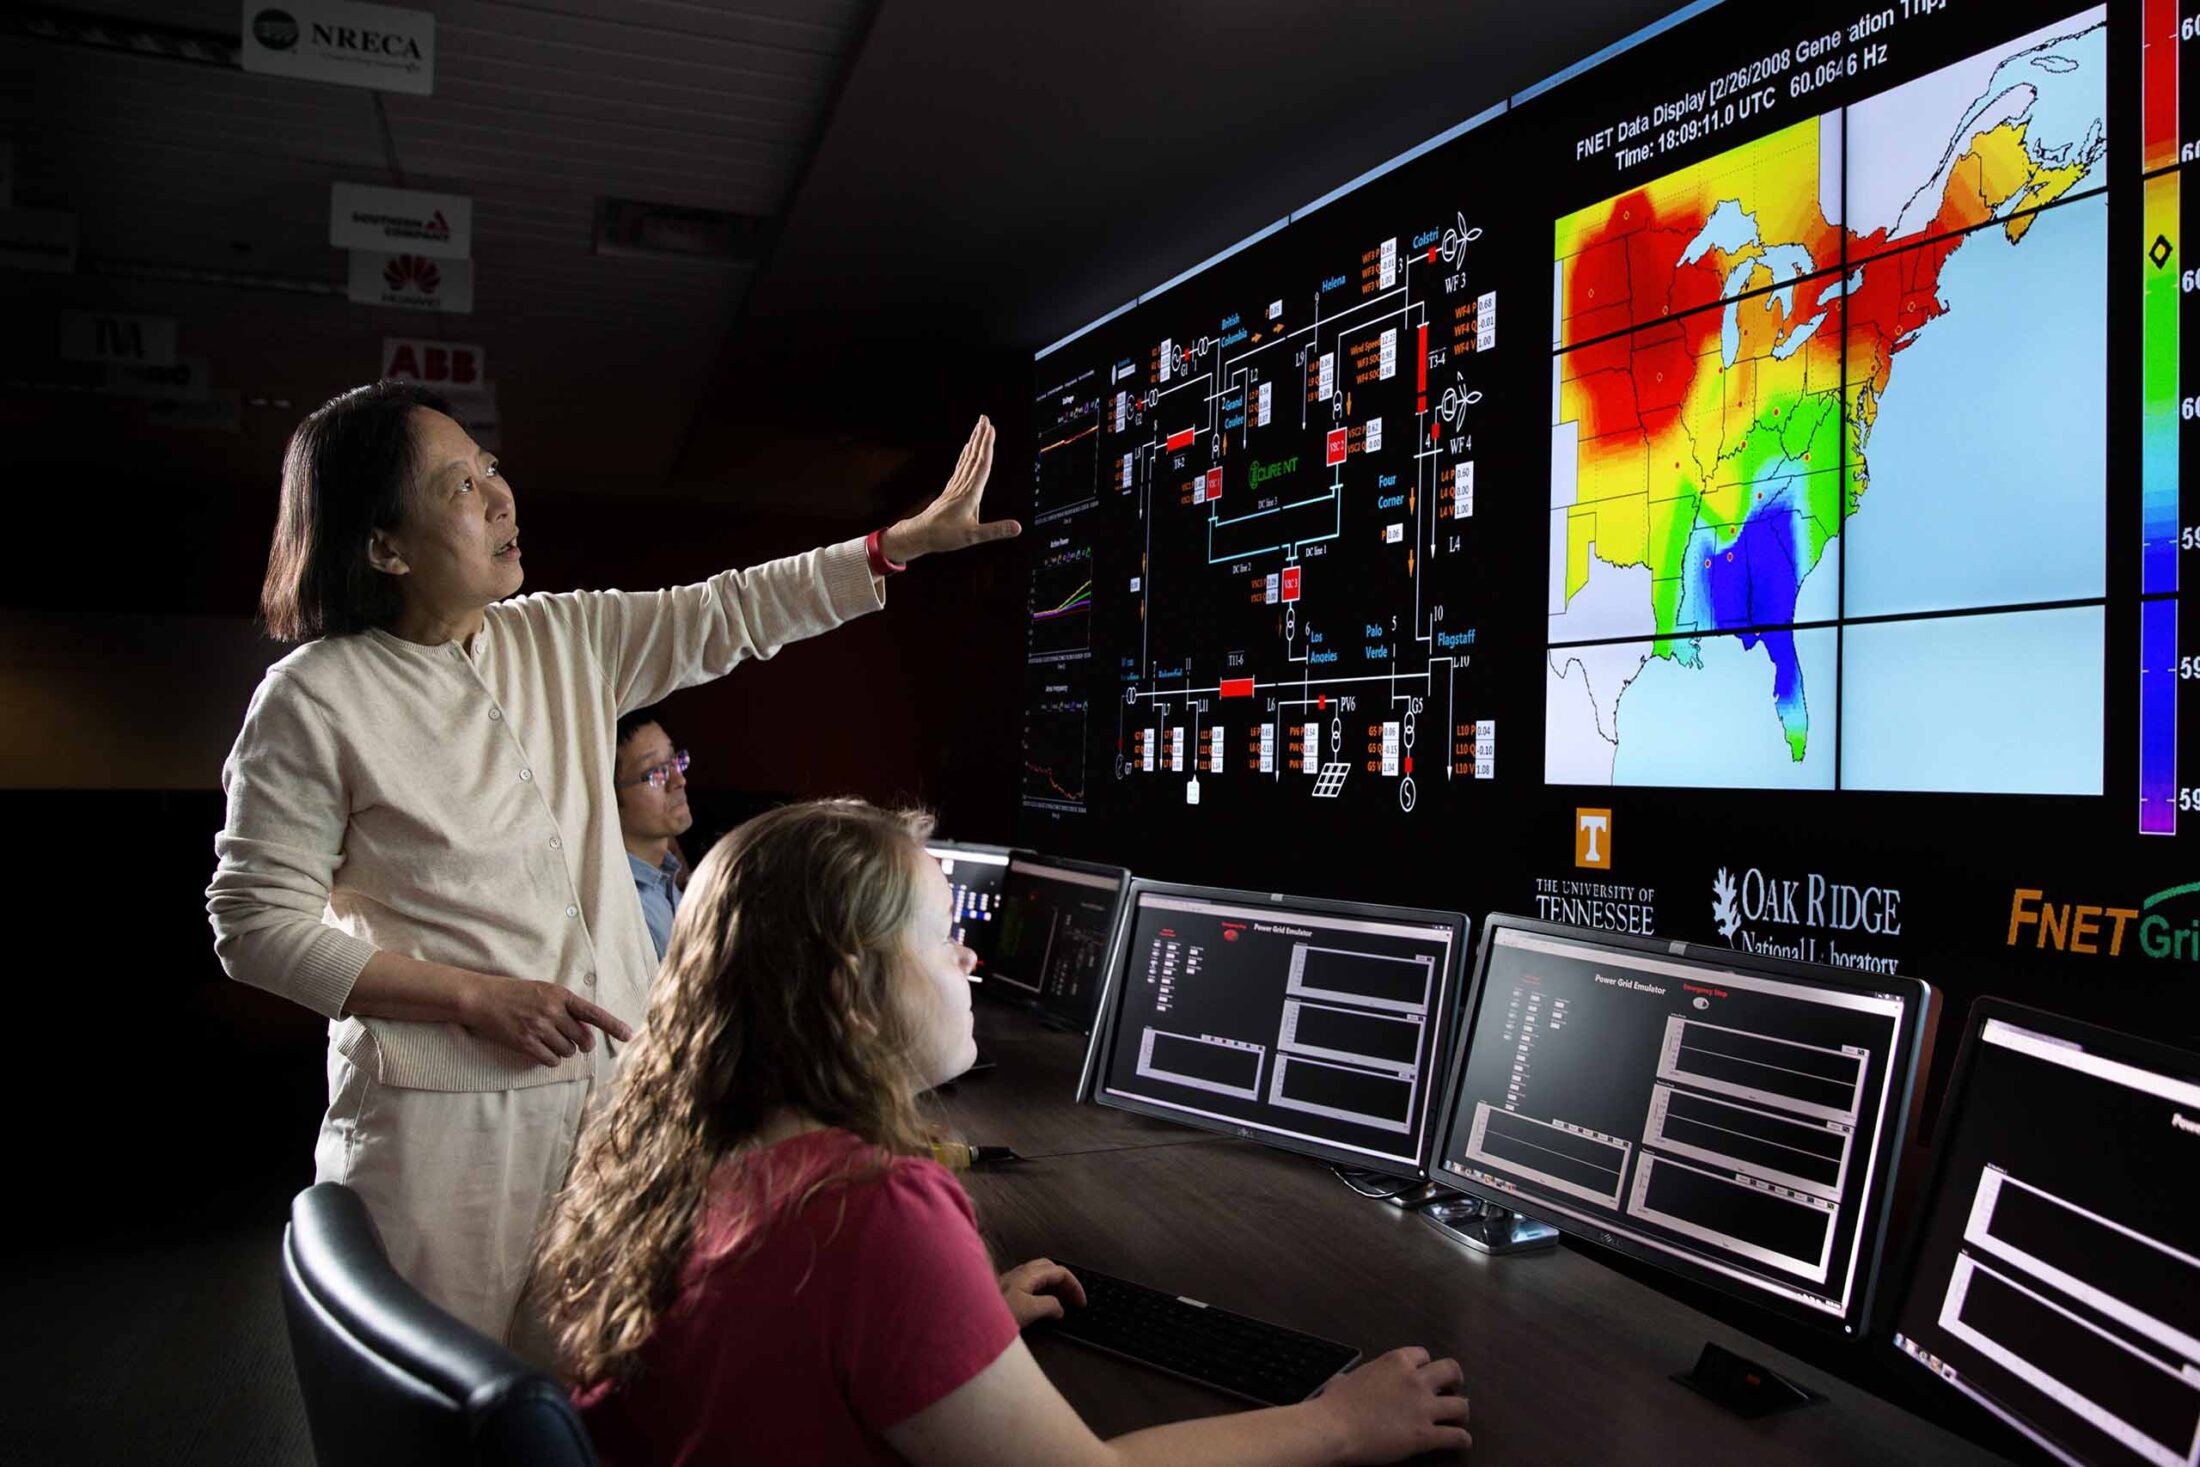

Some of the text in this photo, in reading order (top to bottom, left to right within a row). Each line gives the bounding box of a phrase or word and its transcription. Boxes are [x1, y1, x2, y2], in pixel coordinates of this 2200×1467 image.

[311, 22, 422, 60] NRECA
[1576, 127, 1614, 161] FNET
[1618, 115, 1649, 142] Data
[1653, 90, 1706, 127] Display
[1709, 48, 1790, 107] [2/26/2008
[1901, 0, 1946, 19] Trip
[1615, 142, 1654, 171] Time:
[1658, 104, 1734, 153] 18:09:11.0
[1739, 86, 1776, 119] UTC
[1864, 44, 1888, 70] Hz
[1398, 257, 1404, 273] 3
[1322, 275, 1346, 293] Helena
[1445, 272, 1466, 294] WF 3
[1455, 303, 1470, 319] WF4
[1472, 301, 1477, 314] P
[1454, 322, 1470, 336] WF4
[1471, 319, 1477, 333] Q
[1454, 335, 1492, 355] WF4 V 1.00
[386, 343, 477, 384] ABB
[1295, 351, 1305, 367] L9
[1428, 352, 1446, 369] T3-4
[1250, 368, 1258, 383] L2
[1425, 433, 1431, 448] 4
[1450, 435, 1472, 454] WF 4
[1379, 475, 1397, 488] Four
[1378, 495, 1404, 509] Corner
[1449, 535, 1461, 552] L4
[1434, 605, 1444, 621] 10
[1305, 621, 1311, 636] 6
[1366, 623, 1383, 637] Palo
[1391, 615, 1397, 631] 5
[1311, 631, 1323, 643] Los
[1437, 629, 1476, 649] Flagstaff
[1310, 649, 1338, 664] Angeles
[1365, 645, 1388, 659] Verde
[1267, 697, 1275, 712] L6
[1340, 696, 1356, 712] PV6
[1411, 698, 1423, 713] G5
[1456, 725, 1490, 736] L10 P 0.04
[1456, 744, 1468, 755] L10
[1470, 744, 1476, 757] Q
[1455, 764, 1467, 774] L10
[1469, 764, 1475, 774] V
[1581, 816, 1606, 861] T
[1536, 878, 1655, 902] THE UNIVERSITY OF
[1741, 868, 1901, 935] OAK RIDGE
[1536, 895, 1655, 935] TENNESSEE
[2006, 888, 2139, 956] FNET
[1253, 923, 1272, 934] Power
[1272, 925, 1285, 935] Grid
[1285, 926, 1313, 938] Emulator
[1741, 930, 1899, 975] National Lboratory
[1594, 974, 1666, 995] Power Grid Emulator
